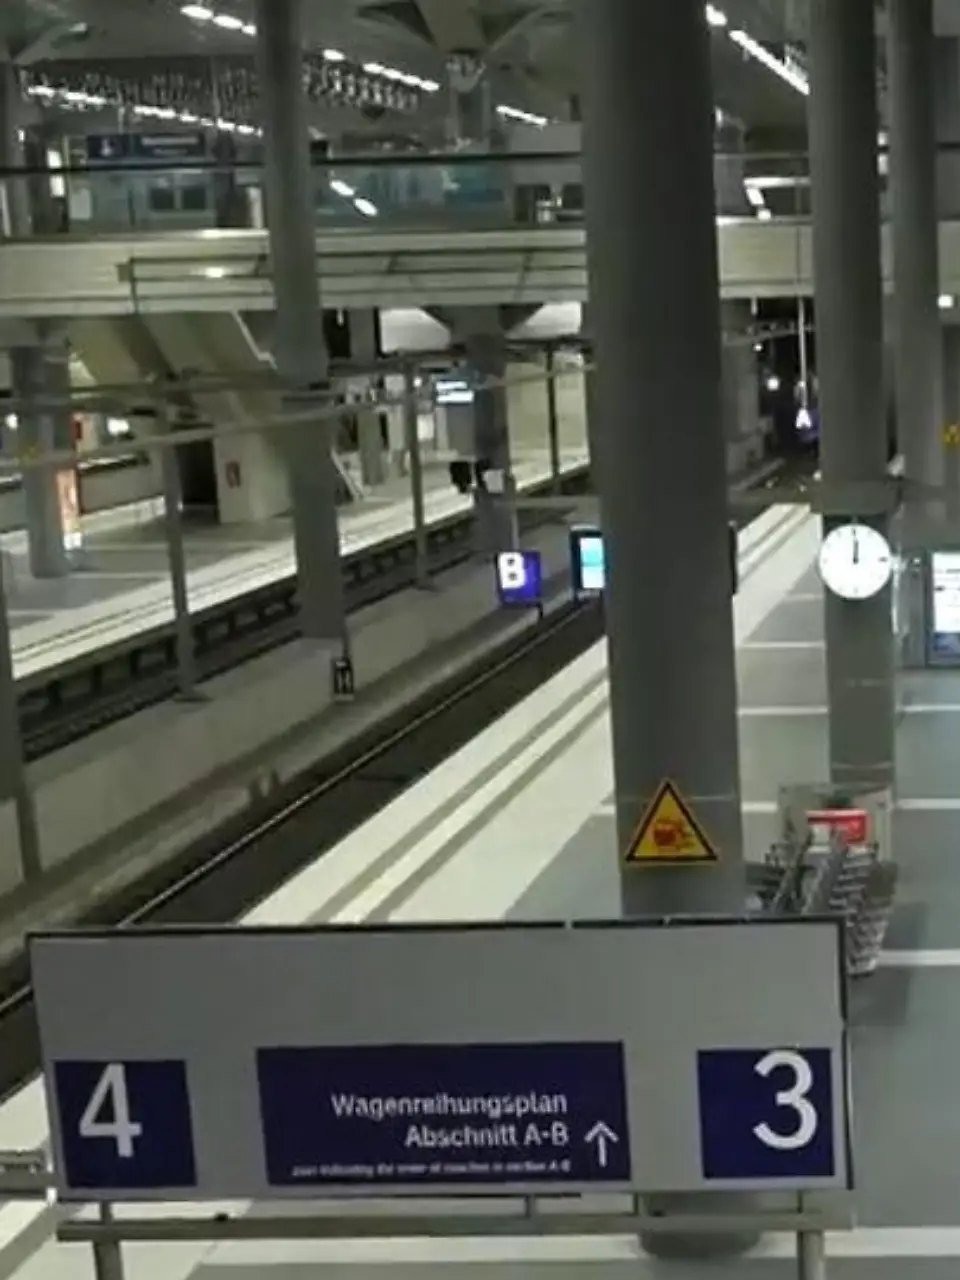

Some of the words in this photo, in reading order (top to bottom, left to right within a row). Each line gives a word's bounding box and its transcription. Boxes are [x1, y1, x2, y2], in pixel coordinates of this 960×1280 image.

[498, 552, 526, 590] B
[79, 1063, 142, 1157] 4
[330, 1091, 568, 1121] Wagenreihungsplan
[753, 1050, 818, 1150] 3
[404, 1124, 519, 1148] Abschnitt
[523, 1121, 569, 1147] A-B
